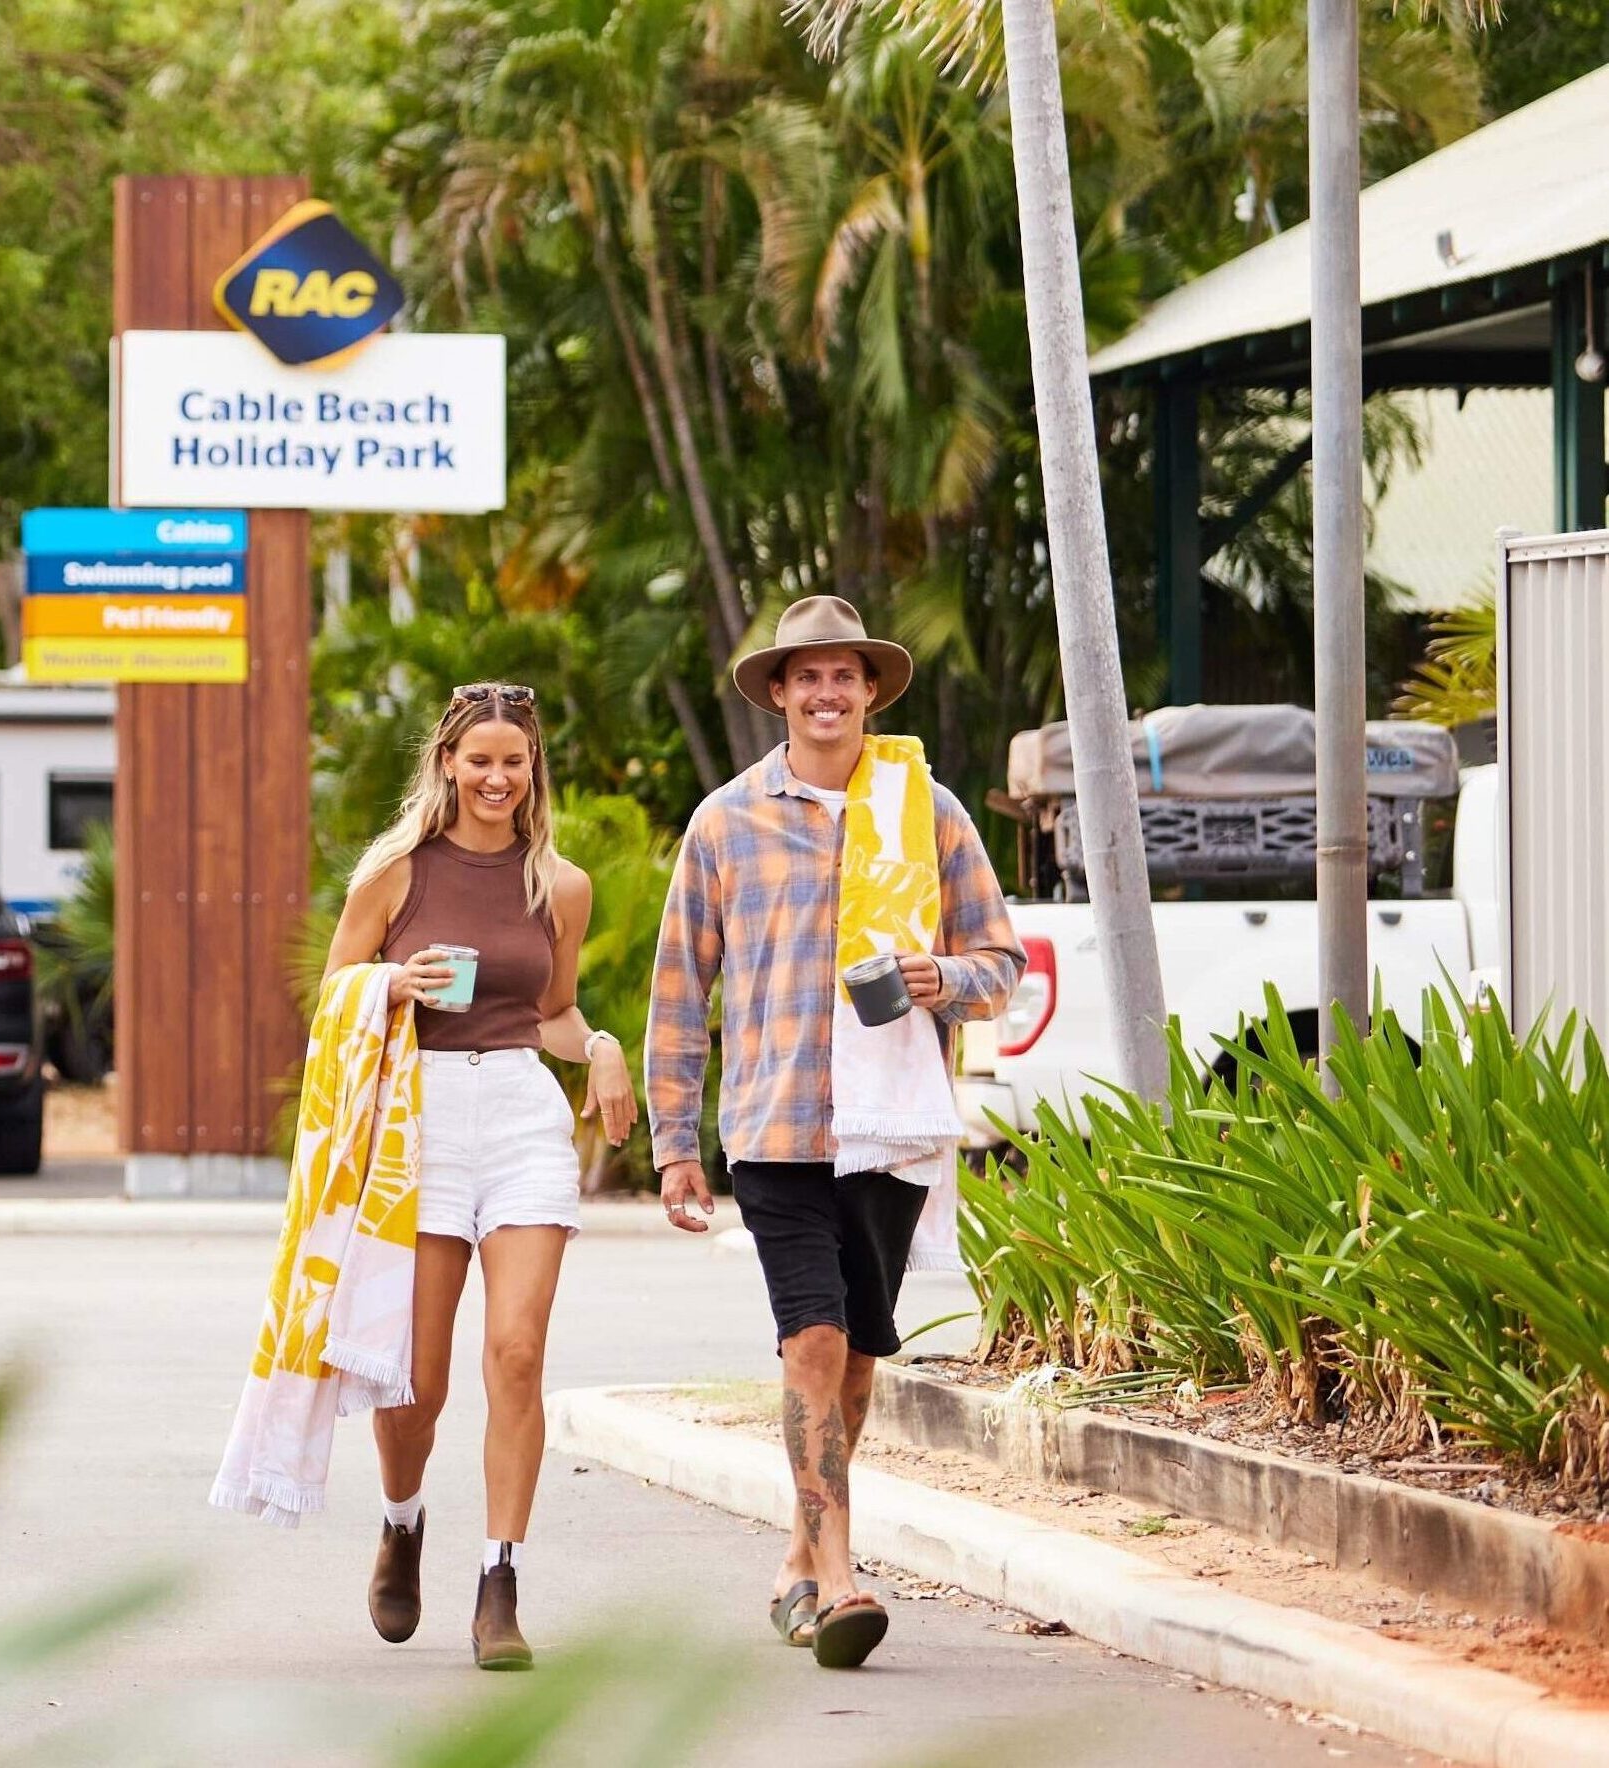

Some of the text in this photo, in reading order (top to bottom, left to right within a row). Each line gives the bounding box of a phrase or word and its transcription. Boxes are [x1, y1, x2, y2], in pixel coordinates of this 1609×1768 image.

[249, 268, 378, 318] RAC
[180, 391, 451, 424] Cable Beach
[172, 436, 456, 475] Holiday Park
[156, 519, 233, 544] Cabins
[63, 561, 233, 590] Swimming pool
[102, 605, 233, 633] Pet Friendly
